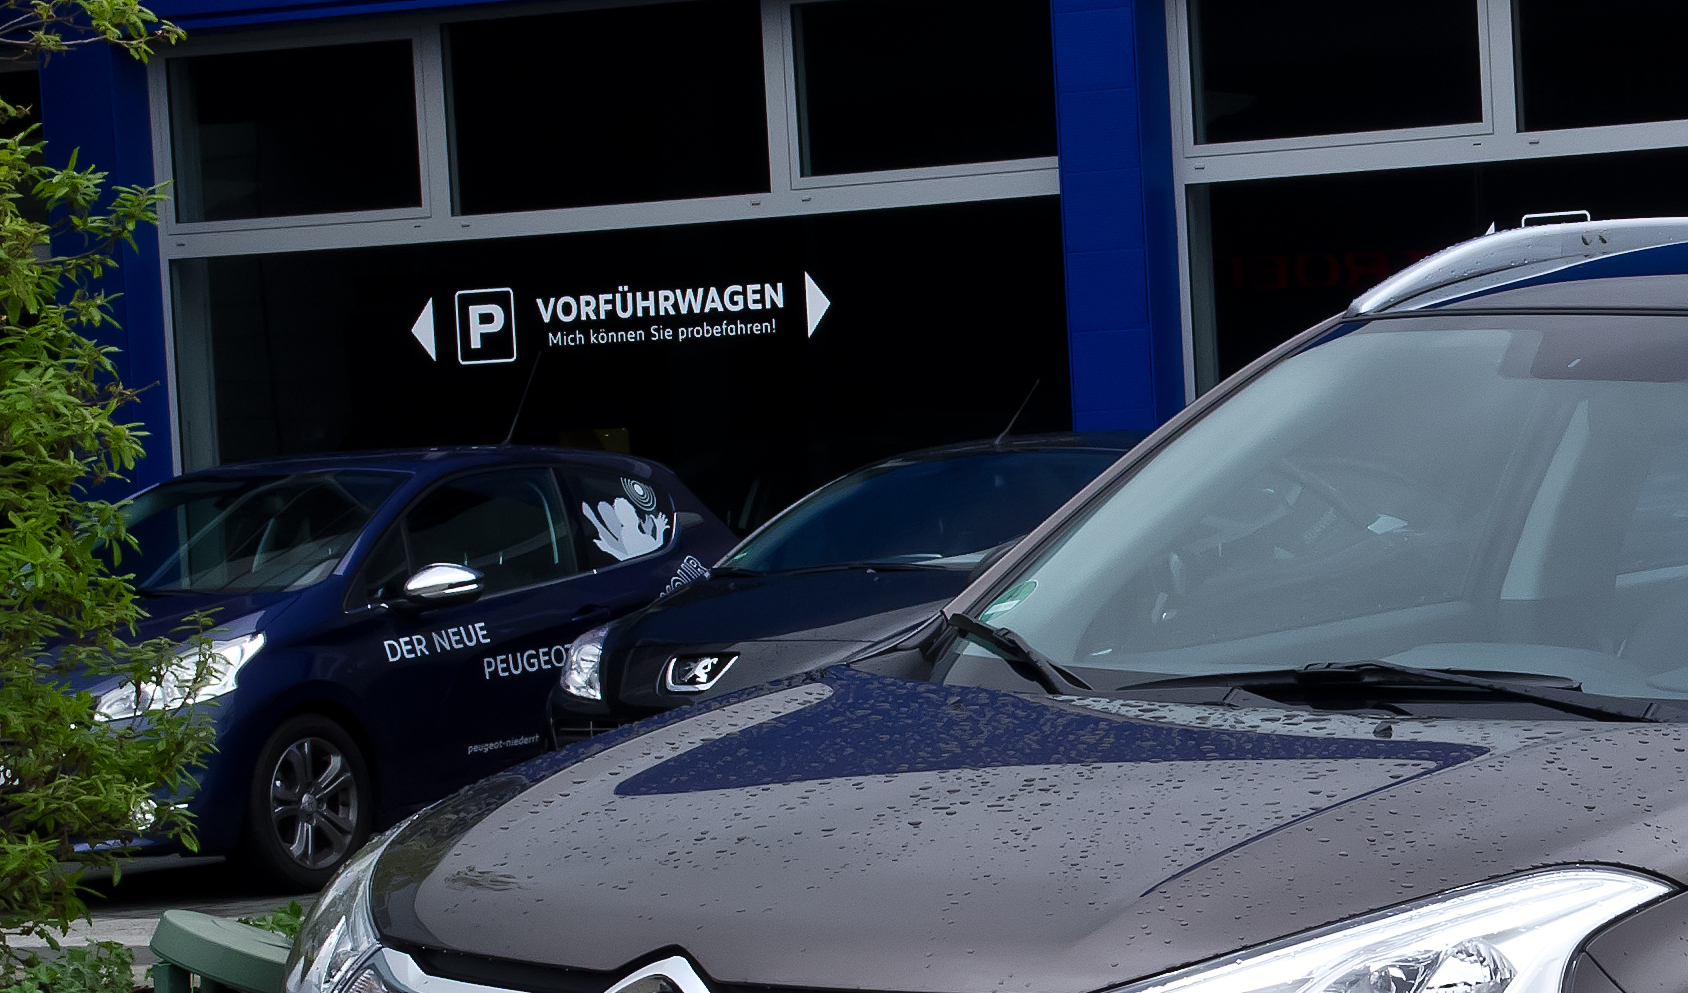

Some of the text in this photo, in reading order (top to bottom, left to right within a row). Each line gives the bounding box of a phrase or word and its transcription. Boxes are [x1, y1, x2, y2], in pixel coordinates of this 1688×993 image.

[535, 282, 785, 323] VORFÜHRWAGEN
[468, 303, 505, 349] P
[548, 318, 776, 347] Mich können Sie probefahren!
[383, 621, 491, 662] DER NEUE
